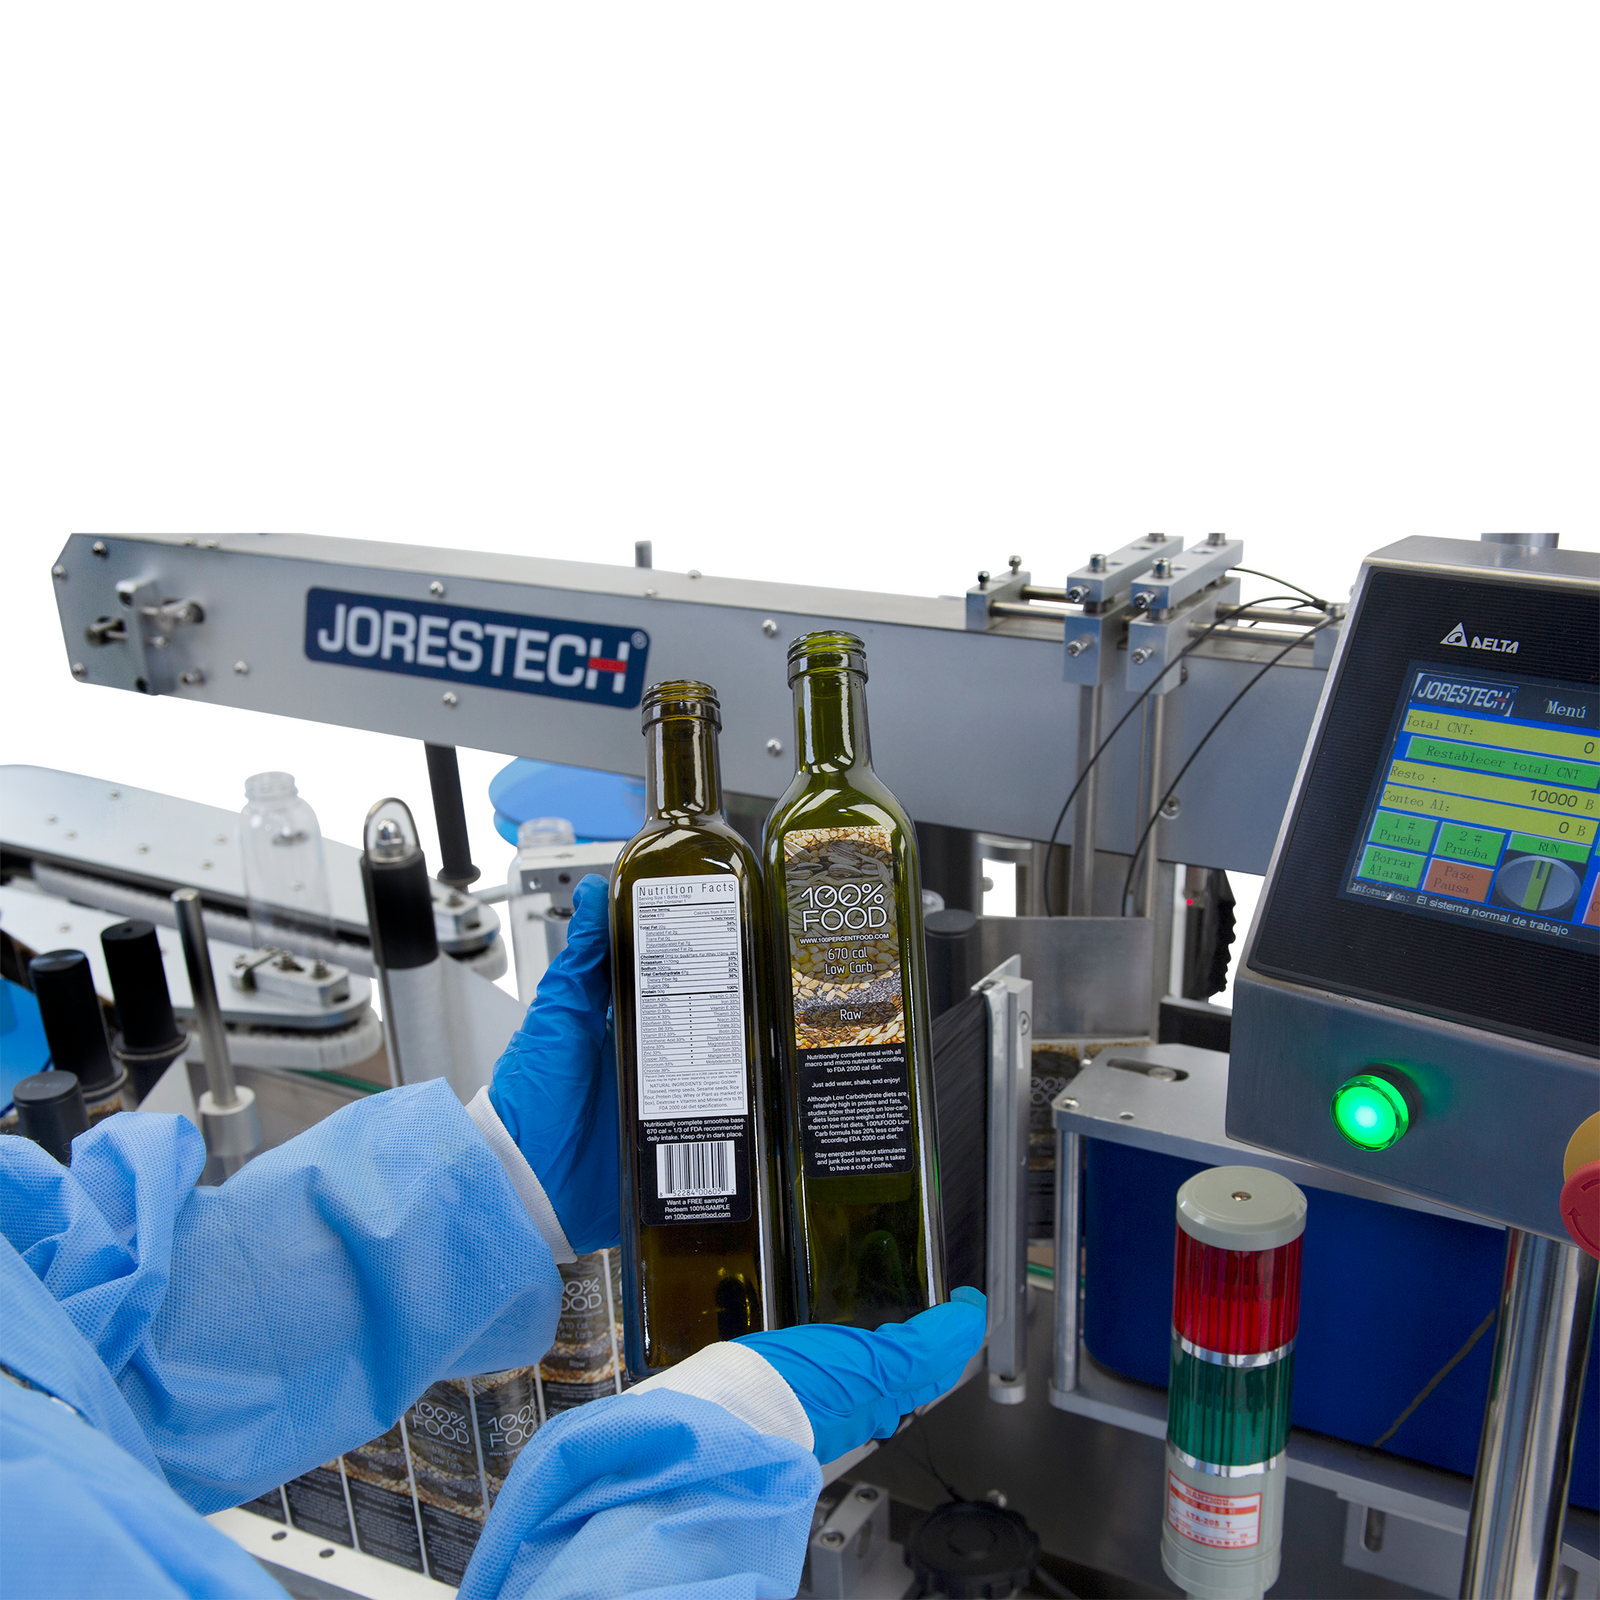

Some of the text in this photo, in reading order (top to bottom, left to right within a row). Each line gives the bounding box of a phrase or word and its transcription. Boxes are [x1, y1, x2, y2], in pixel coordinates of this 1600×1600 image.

[317, 604, 630, 694] JORESTECH
[1471, 636, 1520, 654] DELTA
[1418, 681, 1511, 710] JORESTECH
[1545, 700, 1588, 718] Menú
[1406, 715, 1473, 735] Total CNT:
[1426, 746, 1581, 780] Restablecer total CNT
[1390, 766, 1425, 782] Resto
[1382, 790, 1450, 812] Conteo Al:
[1529, 789, 1594, 811] 10000 B
[1459, 832, 1467, 842] 2
[1558, 821, 1586, 836] 0 B
[1379, 829, 1421, 847] Prueba
[1444, 842, 1488, 860] Prueba
[1538, 842, 1560, 854] RUN
[1372, 852, 1414, 869] Borrar
[1368, 866, 1410, 882] Alarma
[1444, 866, 1474, 881] Pase
[640, 883, 734, 896] Nutrition Facts
[800, 883, 884, 908] 100%
[1433, 878, 1470, 895] Pausa
[802, 906, 888, 932] FOOD
[1416, 895, 1427, 906] El
[1429, 898, 1469, 914] sistema
[1472, 908, 1510, 923] normal
[1512, 915, 1526, 926] de
[1529, 918, 1569, 936] trabajo
[800, 933, 890, 945] WWW.100PERCENTFOOD.COM
[828, 947, 868, 960] 670 cal
[825, 961, 873, 975] Low Carb
[840, 1009, 862, 1020] Raw
[673, 1189, 695, 1197] 52284
[561, 1293, 602, 1311] OOD
[413, 1414, 470, 1445] FOOD
